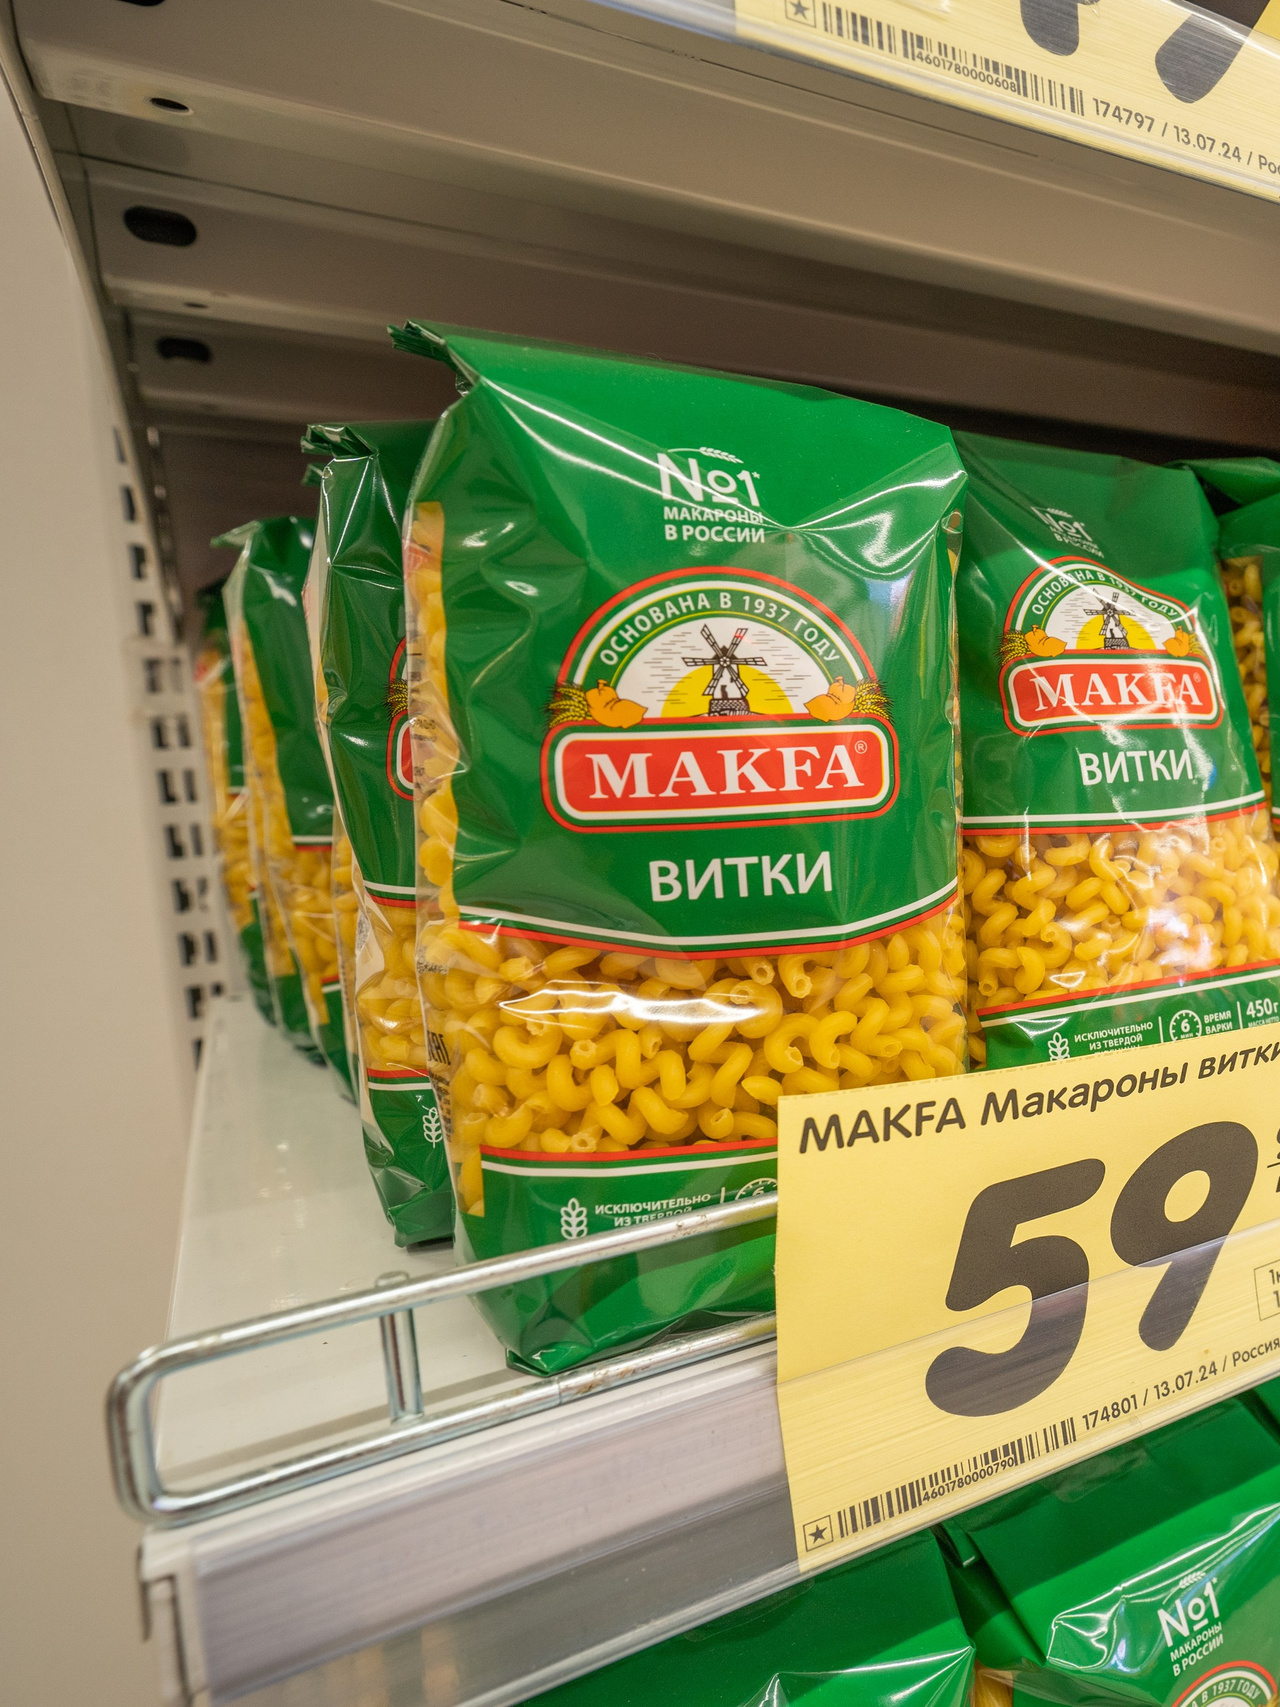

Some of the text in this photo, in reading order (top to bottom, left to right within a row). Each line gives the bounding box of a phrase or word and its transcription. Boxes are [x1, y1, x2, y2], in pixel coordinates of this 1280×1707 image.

[916, 49, 1017, 92] 4601780000608
[1092, 98, 1155, 133] 174797
[1173, 125, 1242, 163] 13.07.24
[663, 506, 764, 524] МАКАРОНЫ
[664, 524, 766, 543] В РОССИИ
[1141, 596, 1179, 617] ГОДУ
[600, 592, 841, 666] ОСНОВАНА В 1937 ГОДУ
[1079, 749, 1194, 786] ВИТКИ
[649, 851, 833, 903] ВИТКИ
[1203, 1010, 1232, 1024] ВРЕМЯ
[1246, 998, 1279, 1018] 450г
[1074, 1021, 1154, 1043] ИСКЛЮЧИТЕЛЬНО
[1181, 1018, 1191, 1033] 6
[1205, 1021, 1233, 1035] ВАРКИ
[1089, 1042, 1102, 1051] ИЗ
[1103, 1033, 1143, 1049] ТВЕРДОЙ
[798, 1097, 967, 1154] MAKFA
[980, 1058, 1186, 1126] Макароны
[595, 1193, 711, 1215] ИСКЛЮЧИТЕЛЬНО
[614, 1216, 632, 1227] ИЗ
[924, 1121, 1259, 1418] 59
[1082, 1393, 1137, 1430] 174801
[1154, 1364, 1218, 1400] 13.07.24
[1232, 1337, 1280, 1367] Россия
[923, 1457, 1015, 1502] 4601780000790
[1170, 1621, 1222, 1662] МАКАРОНЫ
[1172, 1633, 1224, 1677] В РОССИИ
[1201, 1679, 1261, 1704] В 1937 ГОДУ
